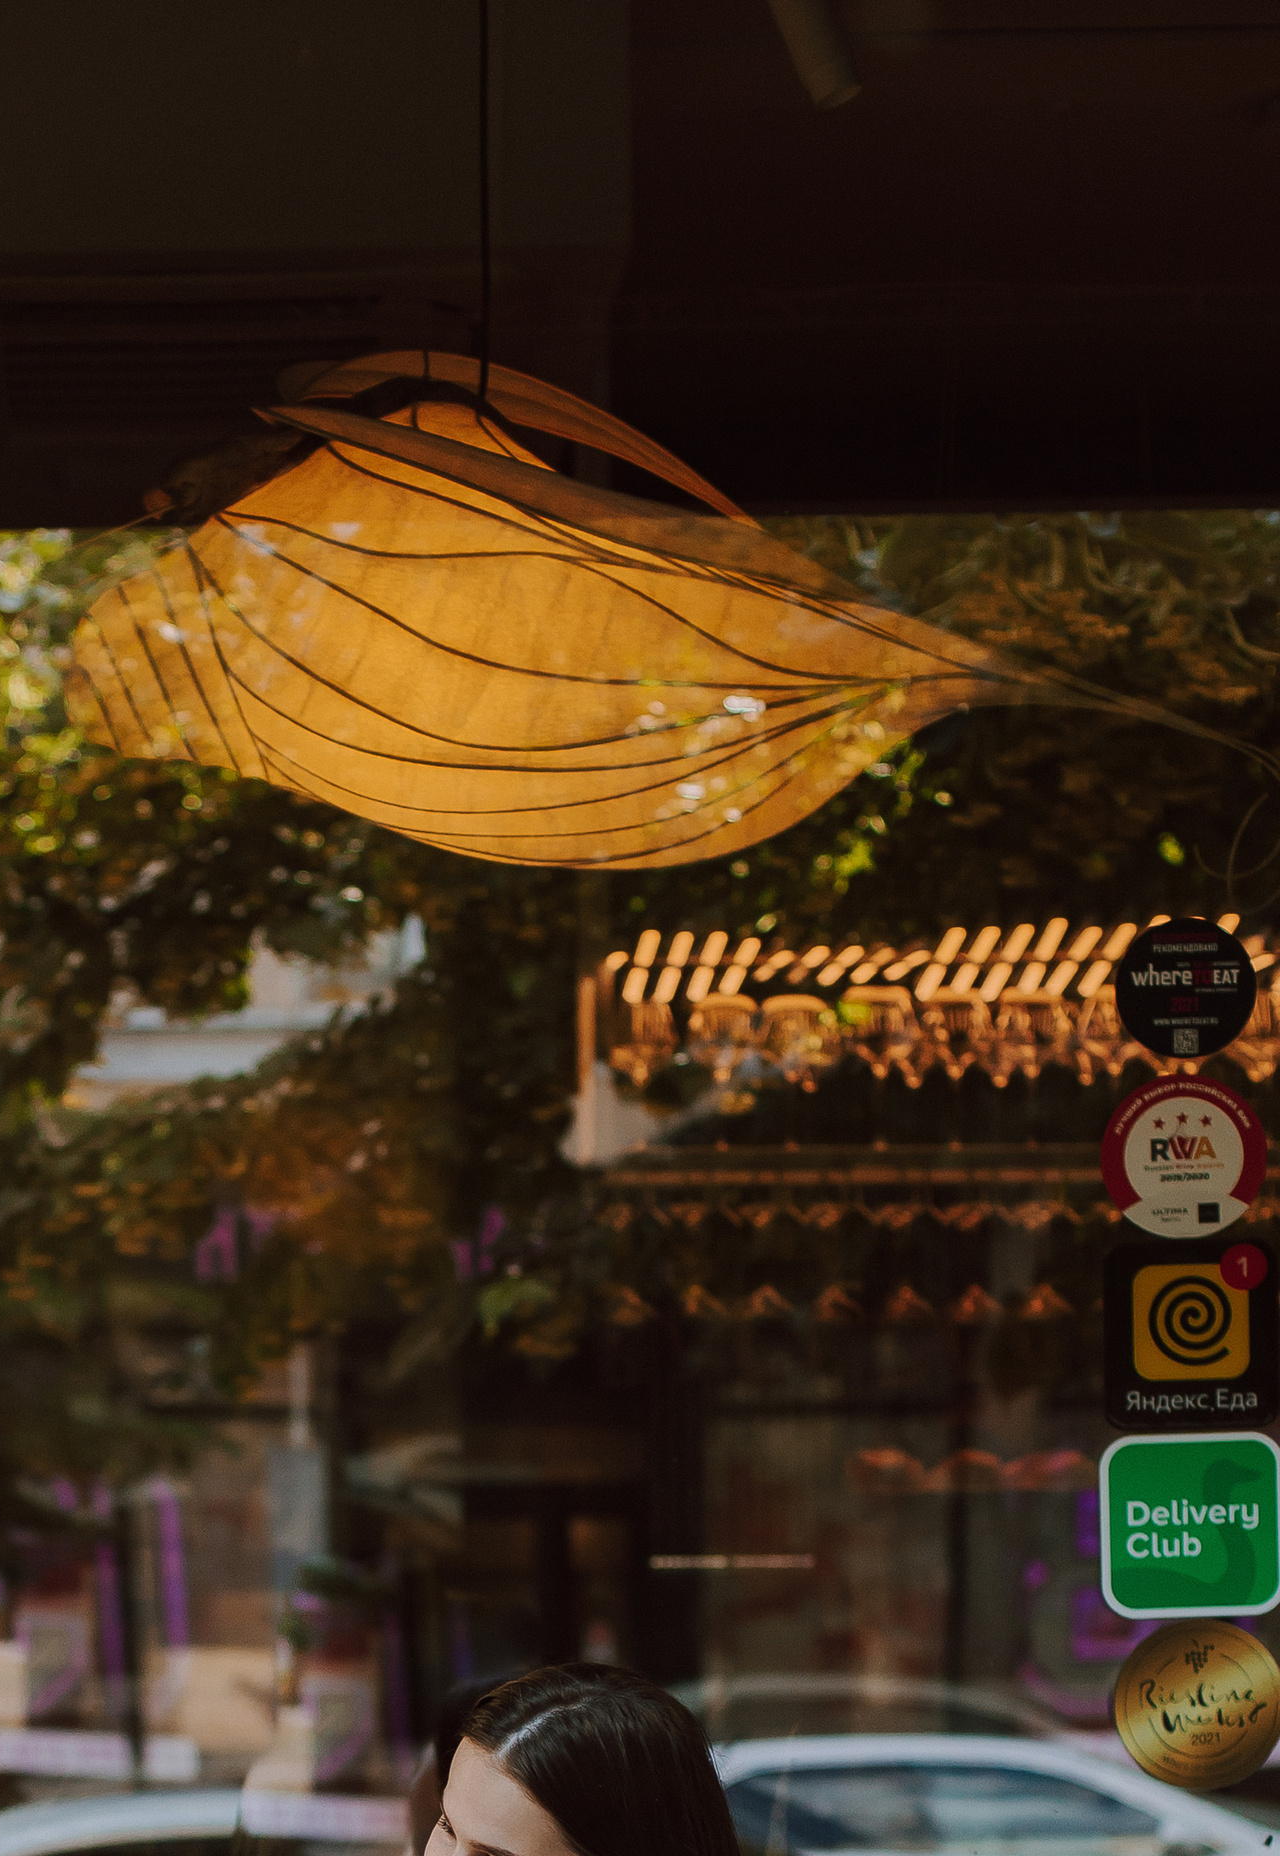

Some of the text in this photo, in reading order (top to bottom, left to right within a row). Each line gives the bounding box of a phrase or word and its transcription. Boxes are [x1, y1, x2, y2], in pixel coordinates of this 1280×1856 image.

[1150, 1136, 1216, 1161] RWA
[1236, 1256, 1248, 1278] 1
[1126, 1388, 1258, 1414] Яндекс.Еда
[1126, 1499, 1260, 1530] Delivery
[1126, 1532, 1202, 1558] Club
[1191, 1732, 1221, 1746] 2021
